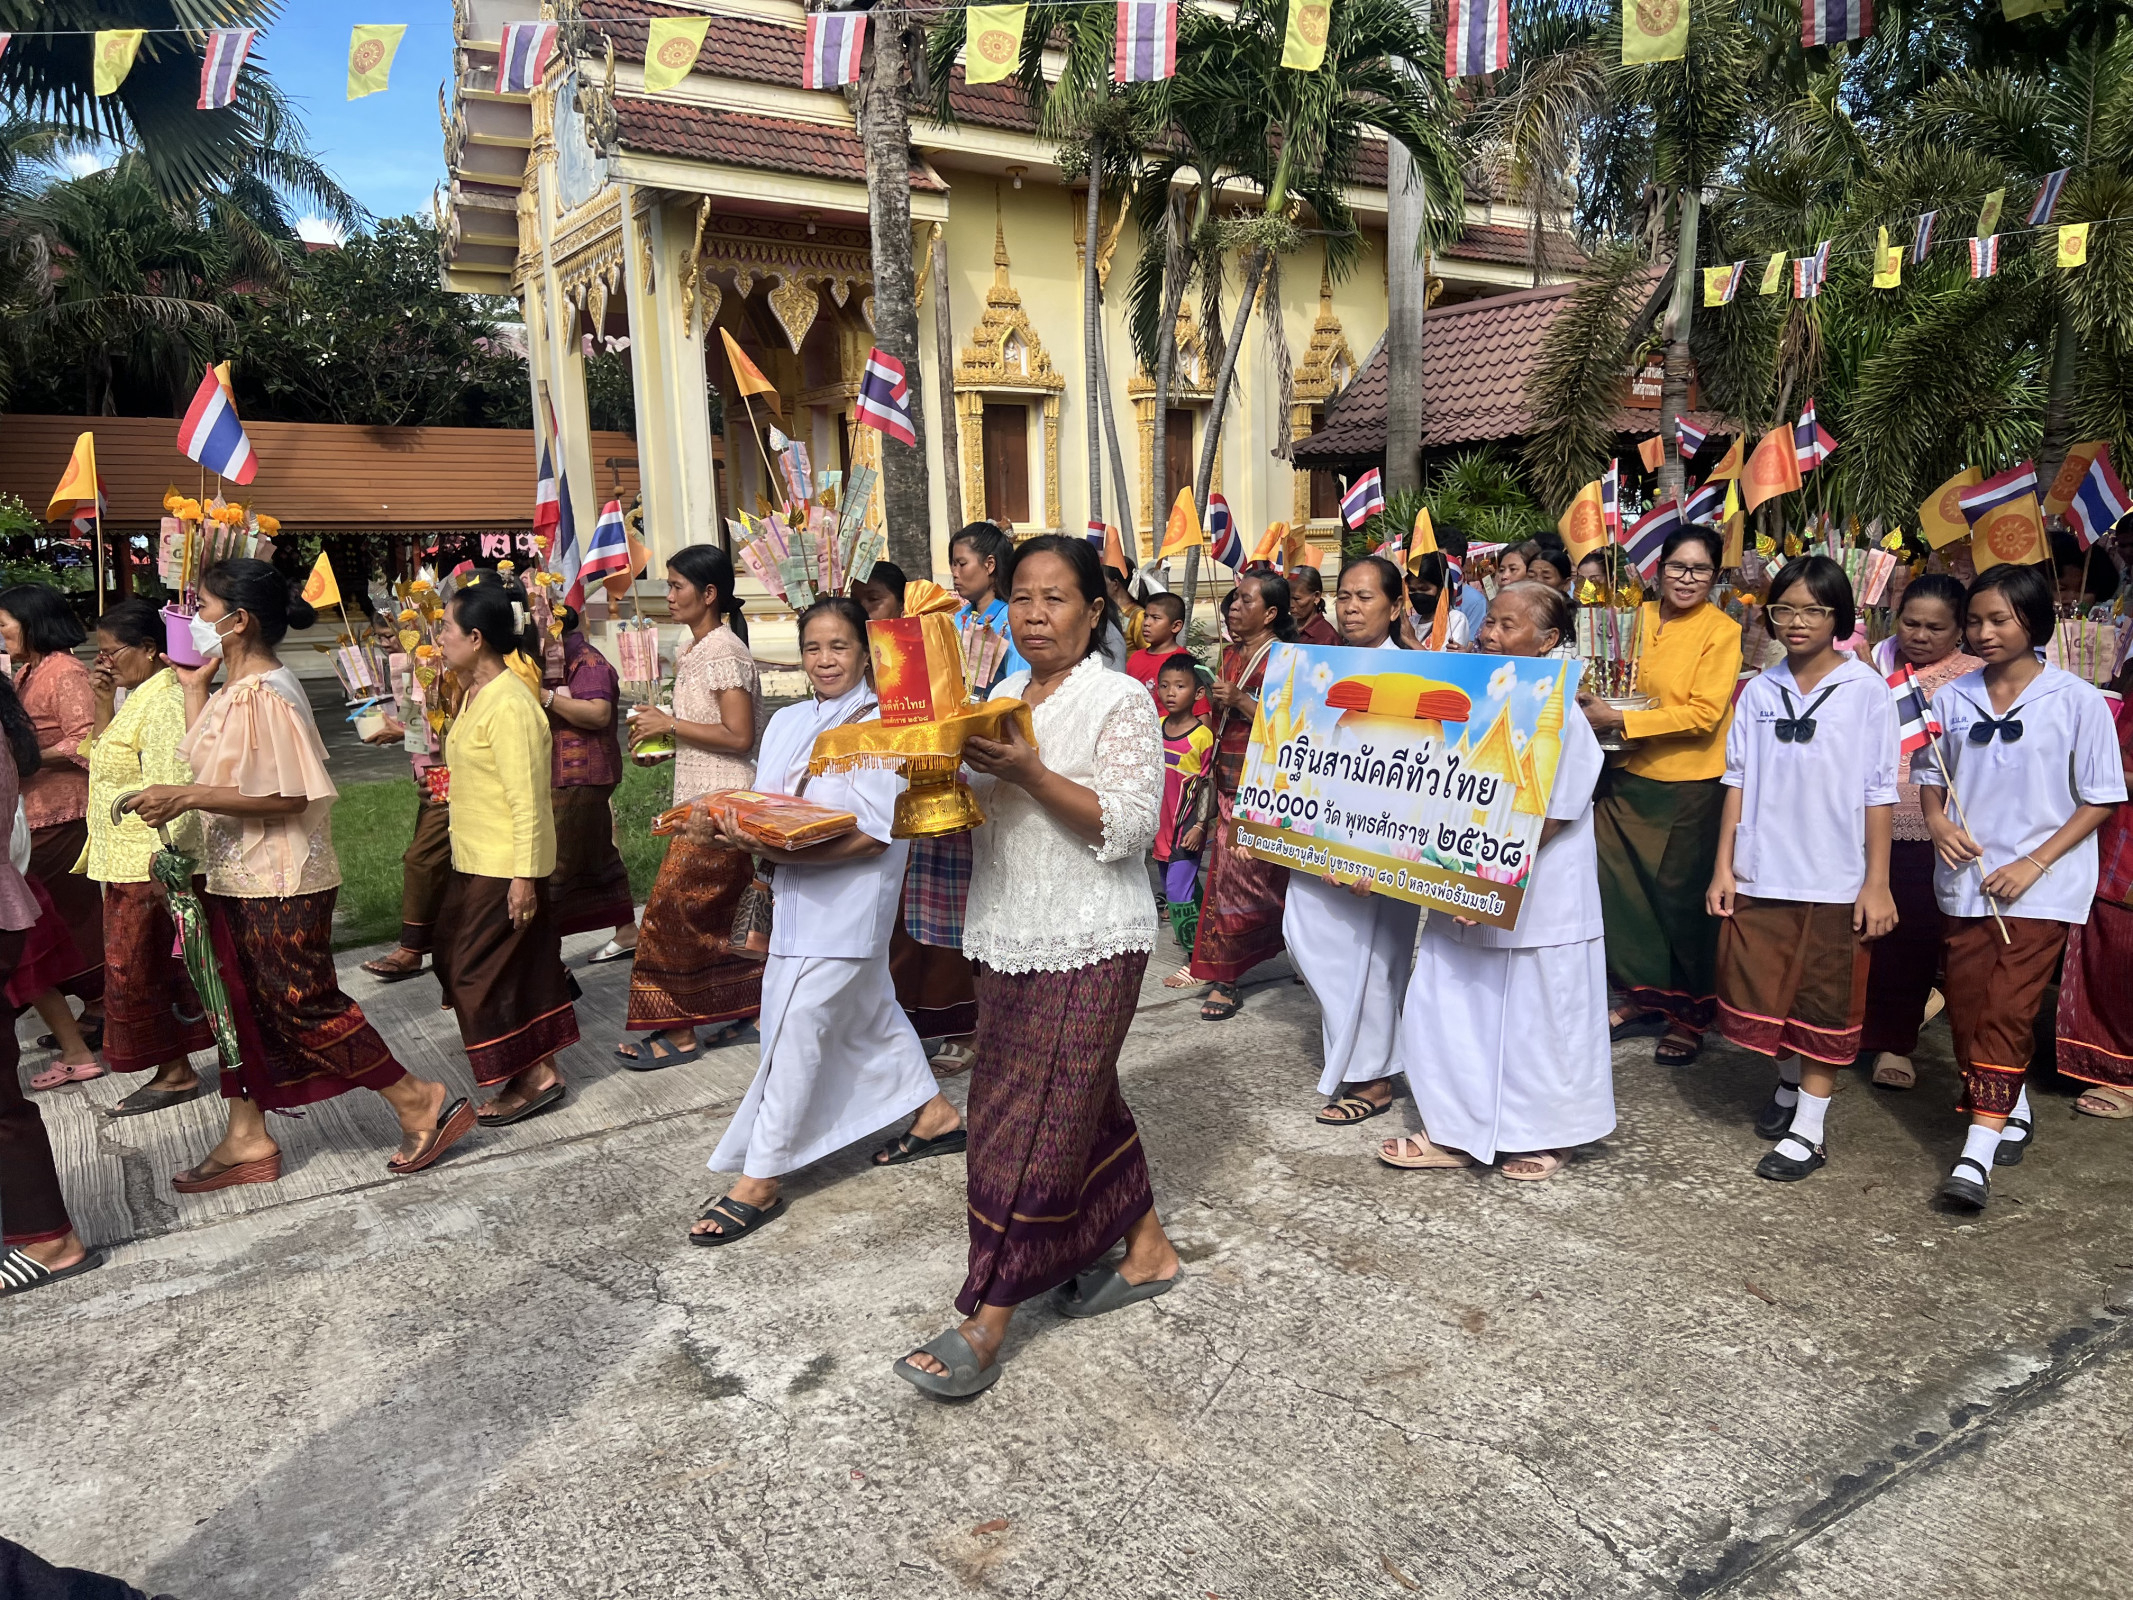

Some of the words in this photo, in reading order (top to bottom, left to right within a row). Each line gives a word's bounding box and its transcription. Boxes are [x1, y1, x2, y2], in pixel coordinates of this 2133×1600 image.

[1277, 734, 1499, 806] กฐินสามัคคีทั่วไทย
[1242, 785, 1319, 820] ๓๐,๐๐๐
[1323, 799, 1341, 826] วัด
[1345, 811, 1429, 846] พุทธศักราช
[1437, 822, 1525, 867] ๒๕๖๘
[1236, 827, 1254, 845] โดย
[1255, 838, 1327, 866] คณะศิษยานุศิษย์
[1329, 855, 1376, 879] บูชาธรรม
[1398, 871, 1406, 887] ปี
[1409, 877, 1504, 914] หลวงพ่อธัมมชโย
